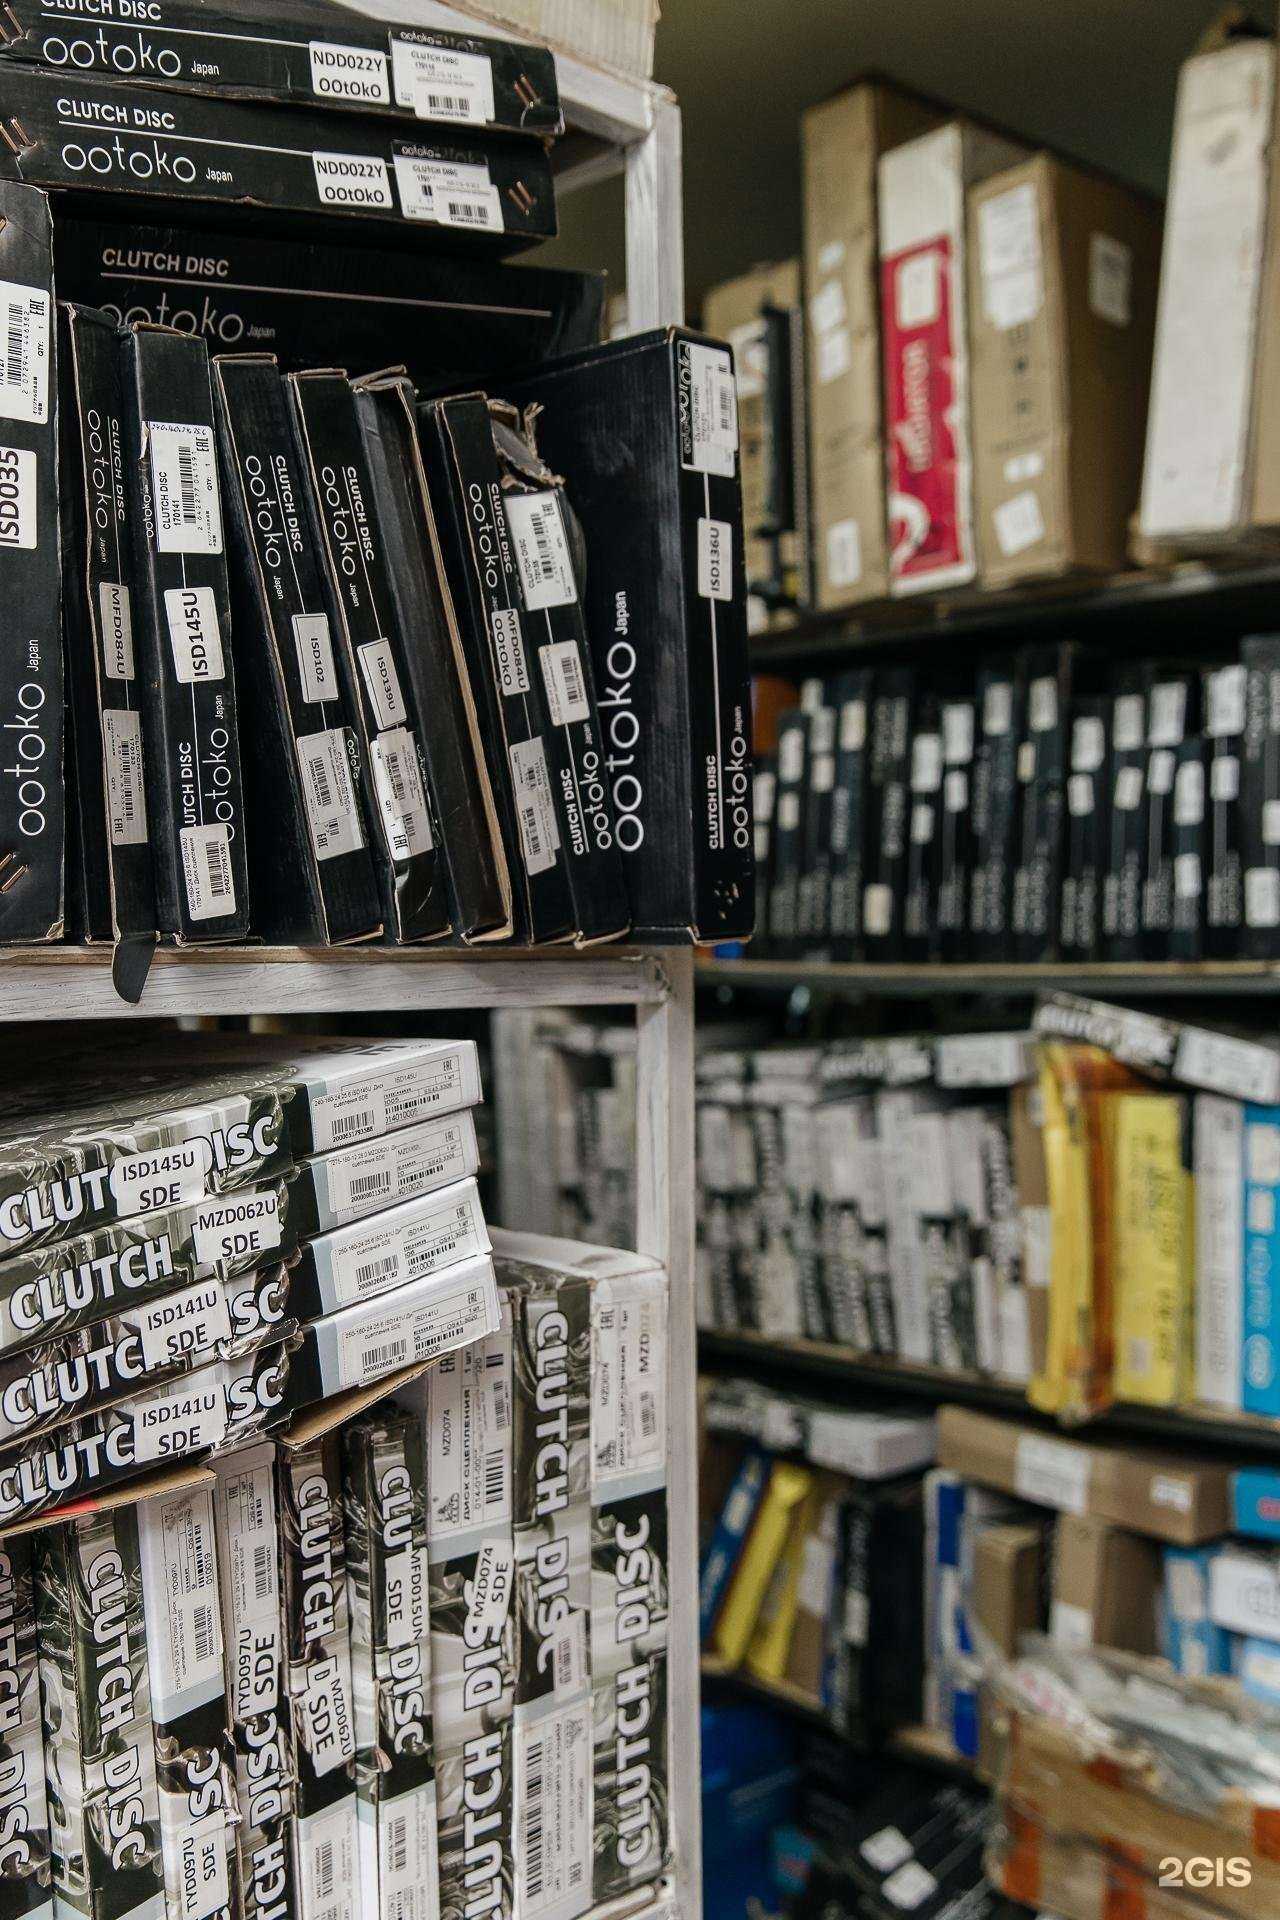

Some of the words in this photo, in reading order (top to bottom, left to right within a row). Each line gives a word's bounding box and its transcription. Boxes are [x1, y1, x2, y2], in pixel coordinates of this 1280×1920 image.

[119, 0, 162, 21] DISC
[43, 28, 181, 77] ootoko
[191, 60, 220, 76] Japan
[313, 51, 383, 72] NDD022Y
[56, 98, 129, 124] CLUTCH
[133, 108, 176, 130] DISC
[61, 135, 197, 183] ootoko
[205, 167, 233, 183] Japan
[317, 160, 383, 178] NDD022Y
[102, 248, 180, 272] CLUTCH
[185, 256, 230, 277] DISC
[247, 323, 276, 339] Japan
[87, 409, 112, 528] ootoko
[111, 417, 123, 484] CLUTCH
[158, 471, 168, 492] DISC
[0, 450, 19, 544] ISD035
[116, 485, 125, 521] DISC
[160, 494, 171, 530] CLUTCH
[171, 499, 181, 526] 170141
[205, 476, 213, 491] QTY:
[275, 455, 295, 513] CLUTCH
[287, 517, 303, 553] DISC
[346, 466, 367, 524] CLUTCH
[359, 526, 375, 562] DISC
[245, 455, 284, 568] ootoko
[273, 575, 284, 600] Japan
[322, 466, 356, 576] ootoko
[349, 583, 360, 607] Japan
[469, 483, 498, 588] ootoko
[490, 483, 508, 541] CLUTCH
[500, 541, 513, 575] DISC
[111, 588, 125, 674] MFD084U
[182, 592, 209, 677] ISD145U
[614, 590, 627, 636] Japan
[309, 637, 325, 684] ISD102
[507, 610, 526, 689] MFD084U
[214, 694, 224, 720] Japan
[377, 656, 396, 710] ISD139U
[3, 683, 46, 836] ootoko
[26, 639, 39, 672] Japan
[597, 641, 645, 852] ootoko
[734, 705, 742, 734] Japan
[178, 741, 193, 779] DISC
[560, 767, 575, 801] DISC
[705, 754, 717, 788] DISC
[725, 735, 749, 849] ootoko
[181, 784, 197, 828] UTCH
[567, 803, 585, 856] CLUTCH
[579, 750, 613, 850] ootoko
[707, 793, 719, 850] CLUTCH
[122, 1150, 196, 1182] ISD145U
[138, 1181, 182, 1210] SDE
[0, 1165, 118, 1240] CLUT
[198, 1198, 277, 1231] MZD062U
[220, 1230, 261, 1258] SDE
[9, 1233, 174, 1331] CLUTCH
[147, 1290, 218, 1331] ISD141U
[3, 1335, 149, 1425] CLUTC
[226, 1282, 285, 1338] SC
[166, 1324, 209, 1357] SDE
[0, 1423, 136, 1514] CLUTC
[223, 1366, 283, 1421] SC
[142, 1393, 217, 1428] ISD141U
[157, 1425, 202, 1457] SDE
[440, 1409, 452, 1456] MZD074
[462, 1389, 471, 1478] СЦЕПЛЕНИЯ
[535, 1310, 570, 1517] CLUTCH
[381, 1465, 414, 1553] CLU
[462, 1481, 471, 1521] ДИСК
[298, 1474, 336, 1644] CLUTCH
[474, 1547, 494, 1618] MZD074
[491, 1561, 509, 1603] SDE
[615, 1513, 652, 1645] DISC
[387, 1579, 403, 1624] SDE
[88, 1550, 136, 1734] CLUTCH
[238, 1628, 251, 1716] TYD097U
[254, 1633, 275, 1700] SDE
[464, 1578, 503, 1711] DIS
[308, 1694, 336, 1755] SDE
[329, 1678, 354, 1757] MZD062U
[389, 1643, 425, 1755] DISC
[245, 1712, 283, 1829] DISC
[616, 1662, 653, 1869] CLUTCH
[102, 1743, 147, 1872] DISC
[464, 1731, 503, 1920] LUTCH
[182, 1837, 197, 1913] TYD097U
[202, 1842, 217, 1882] SDE
[254, 1838, 288, 1920] TCH
